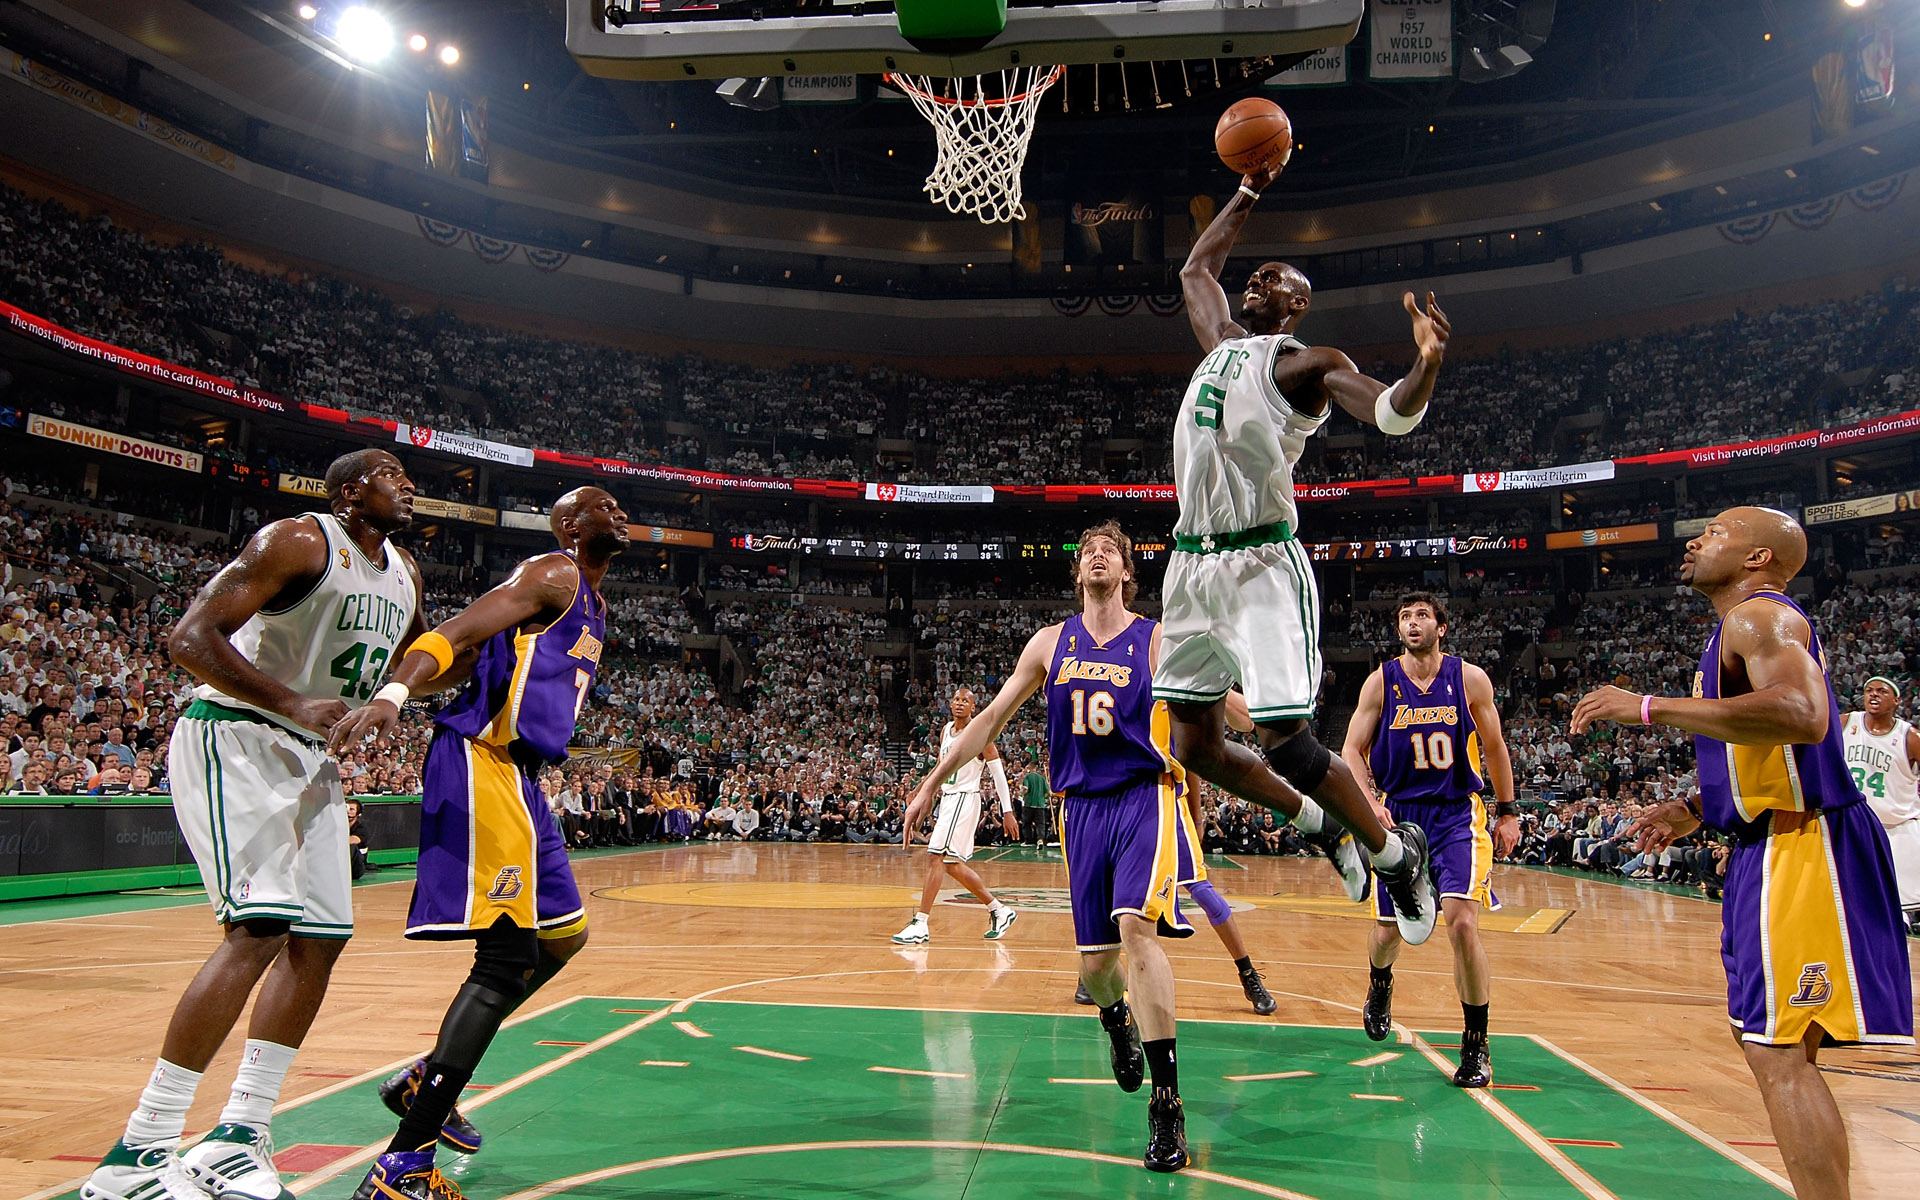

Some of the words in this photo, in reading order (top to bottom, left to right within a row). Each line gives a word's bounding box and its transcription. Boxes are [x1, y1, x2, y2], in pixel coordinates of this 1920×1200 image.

[1400, 22, 1425, 34] 1957
[1390, 37, 1433, 49] WORLD
[1289, 57, 1341, 71] MPIONS
[1376, 52, 1447, 65] CHAMPIONS
[788, 75, 853, 89] CHAMPIONS
[1098, 202, 1153, 223] Finals
[10, 312, 28, 329] The
[29, 322, 51, 340] most
[53, 331, 101, 359] important
[103, 351, 135, 368] name
[136, 361, 150, 373] on
[152, 364, 170, 378] the
[171, 371, 193, 385] card
[195, 377, 215, 392] isn't
[217, 385, 240, 399] ours.
[243, 390, 257, 403] It's
[258, 396, 285, 412] yours.
[1195, 382, 1227, 430] 5
[45, 422, 119, 451] DUNKIN'
[119, 441, 183, 467] DONUTS
[1692, 452, 1716, 463] Visit
[1717, 437, 1818, 460] harvardpilgrim.org
[1819, 432, 1834, 444] for
[1836, 429, 1865, 440] more
[1867, 416, 1920, 434] informati
[434, 432, 476, 452] Harvard
[475, 442, 509, 462] Pilgrim
[601, 463, 620, 474] Visit
[622, 465, 701, 485] harvardpilgrim.org
[702, 474, 714, 484] for
[716, 478, 738, 487] more
[739, 478, 793, 491] information.
[1503, 472, 1549, 483] Harvard
[1549, 471, 1587, 484] Pilgrim
[900, 487, 937, 499] Harvard
[938, 490, 971, 502] Pilgrim
[1103, 488, 1123, 499] You
[1129, 488, 1153, 499] don't
[1155, 490, 1174, 499] see
[1293, 488, 1308, 498] our
[1311, 486, 1350, 498] doctor.
[1807, 503, 1846, 516] SPORTS
[1834, 508, 1860, 521] DESK
[730, 537, 744, 549] 15
[752, 538, 765, 548] The
[763, 535, 799, 550] Finals
[801, 537, 818, 546] REB
[1426, 538, 1445, 546] REB
[1600, 531, 1619, 541] at&t
[826, 539, 842, 547] AST
[851, 540, 866, 548] STL
[906, 543, 921, 551] 3PT
[1134, 543, 1166, 551] LAKERS
[1314, 544, 1330, 552] 3PT
[1350, 542, 1362, 550] TO
[1374, 541, 1391, 549] STL
[1399, 540, 1417, 548] AST
[1457, 539, 1470, 550] The
[1467, 535, 1508, 551] Finals
[1511, 538, 1527, 550] 15
[879, 550, 885, 558] 3
[1142, 550, 1155, 560] 10
[1378, 549, 1384, 558] 2
[1404, 548, 1411, 557] 4
[1431, 547, 1438, 556] 2
[336, 593, 404, 646] CELTICS
[330, 641, 389, 701] 43
[1054, 656, 1132, 687] LAKERS
[574, 667, 591, 721] 7
[1071, 689, 1115, 736] 16
[1389, 704, 1458, 730] LAKERS
[1410, 731, 1454, 770] 10
[1847, 744, 1892, 772] CELTICS
[1849, 766, 1886, 798] 34
[116, 828, 138, 844] abc
[141, 827, 174, 846] Home
